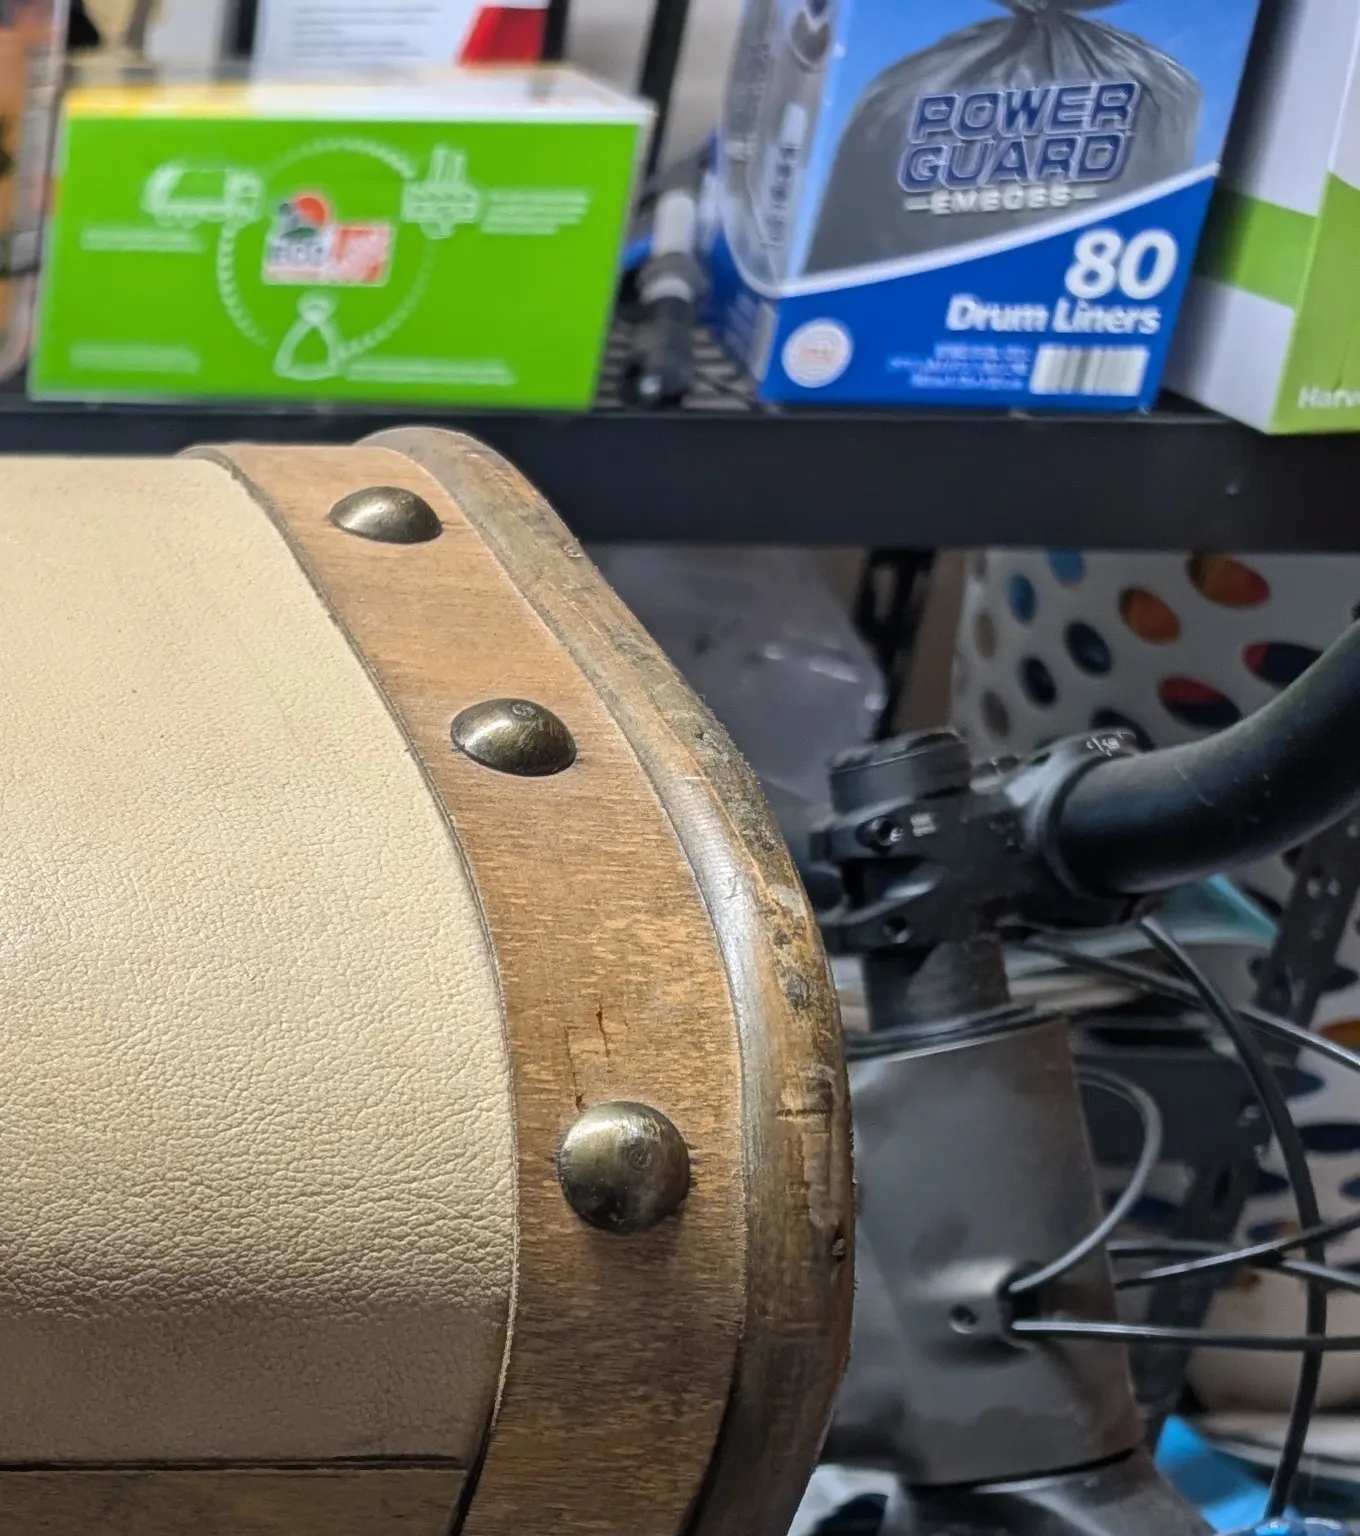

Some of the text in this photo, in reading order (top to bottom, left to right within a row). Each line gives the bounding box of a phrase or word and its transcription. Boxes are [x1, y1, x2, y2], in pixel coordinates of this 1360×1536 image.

[908, 81, 1141, 144] POWER
[897, 130, 1126, 193] GUARD
[1064, 228, 1178, 301] 80
[945, 293, 1162, 335] Drum Liners
